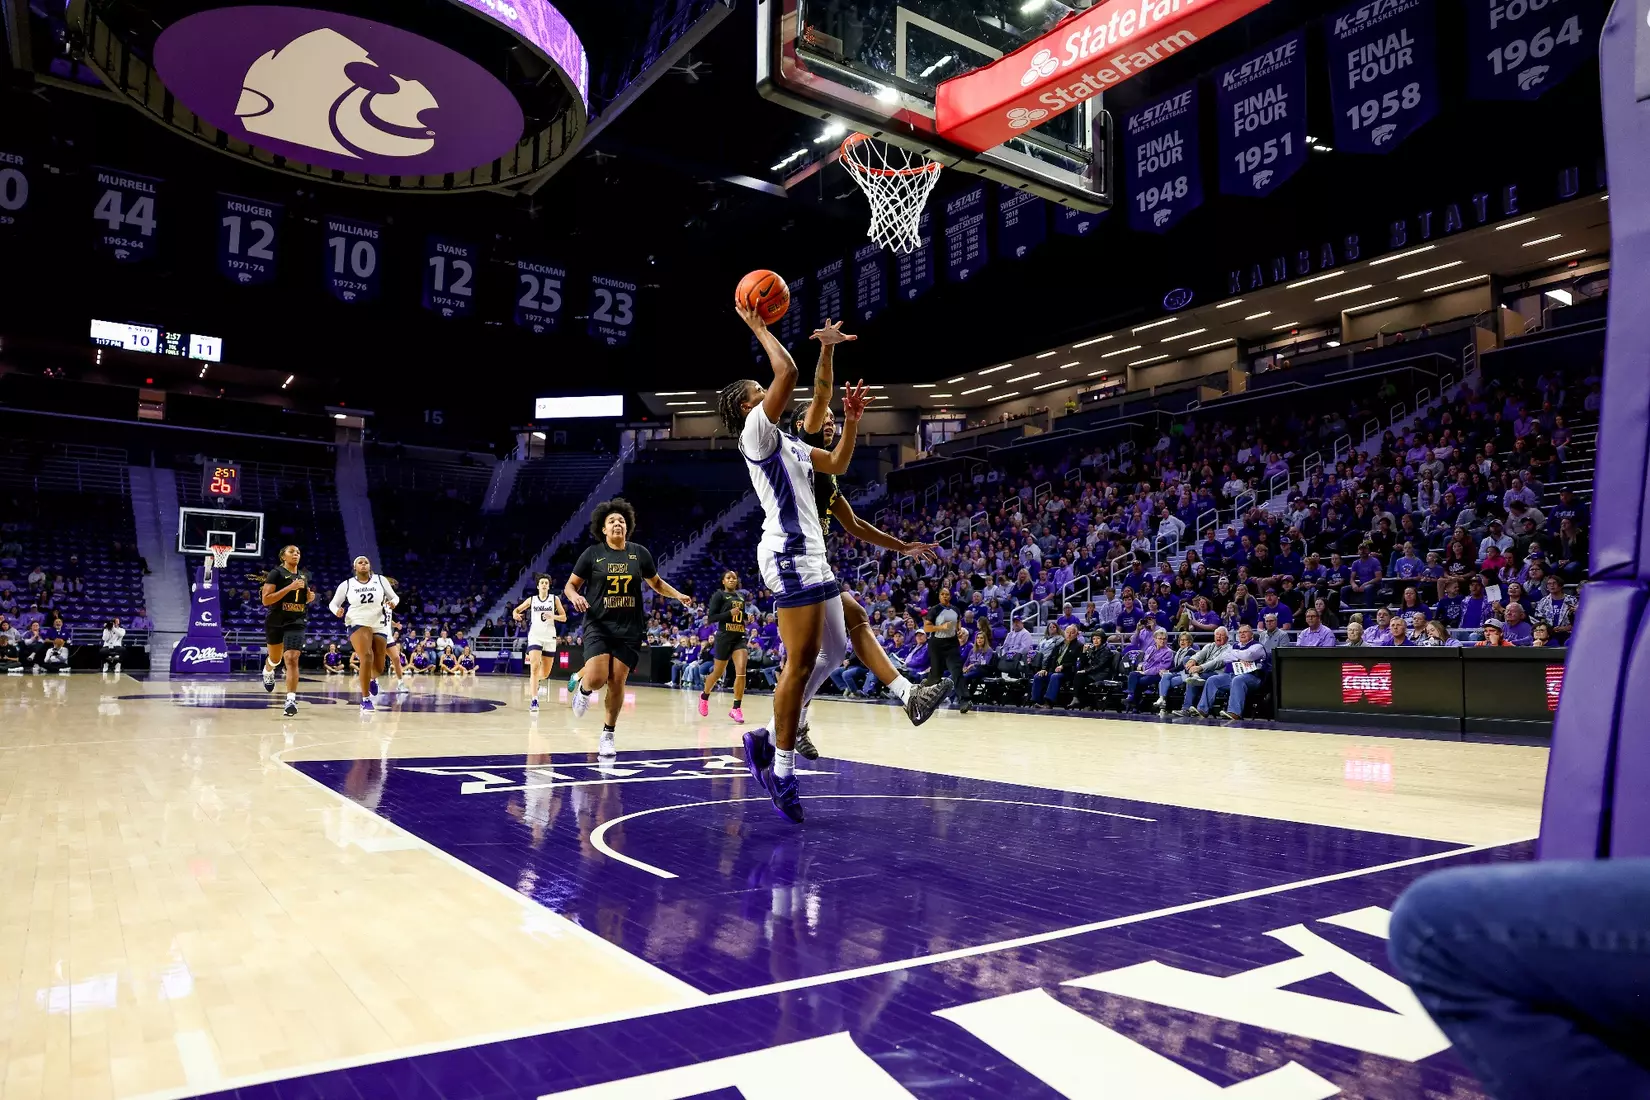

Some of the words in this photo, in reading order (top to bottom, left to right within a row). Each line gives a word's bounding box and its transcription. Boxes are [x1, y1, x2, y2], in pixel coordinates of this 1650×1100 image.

[1347, 27, 1415, 71] FINAL
[1487, 14, 1584, 76] 1964
[1222, 39, 1298, 89] K-STATE
[1348, 47, 1415, 90] FOUR
[1127, 89, 1193, 131] K-STATE
[1233, 83, 1289, 120] FINAL
[1346, 81, 1422, 131] 1958
[1233, 101, 1288, 138] FOUR
[1136, 129, 1184, 162] FINAL
[1234, 131, 1293, 174] 1951
[1137, 146, 1184, 178] FOUR
[97, 173, 157, 194] MURRELL
[1136, 175, 1188, 212] 1948
[227, 201, 273, 218] KRUGER
[947, 188, 983, 213] K-STATE
[1000, 197, 1019, 211] SWEET
[93, 189, 157, 236] 44
[1005, 208, 1019, 220] 2018
[1005, 216, 1019, 227] 2023
[329, 221, 379, 239] WILLIAMS
[945, 222, 962, 236] SWEET
[962, 213, 984, 228] SIXTEEN
[103, 236, 144, 249] 1962-64
[222, 215, 275, 260] 12
[1227, 231, 1361, 294] KANSAS
[1389, 182, 1521, 249] STATE
[328, 236, 377, 278] 10
[436, 243, 468, 257] EVANS
[227, 259, 265, 273] 1971-74
[429, 256, 473, 296] 12
[518, 260, 566, 277] BLACKMAN
[861, 261, 876, 273] NCAA
[333, 279, 367, 291] 1972-76
[518, 274, 562, 312] 25
[592, 275, 637, 291] RICHMOND
[593, 288, 634, 325] 23
[132, 334, 150, 347] 10
[165, 332, 181, 341] 2:57
[197, 344, 212, 356] 11
[423, 409, 444, 425] 15
[214, 467, 235, 478] 2:57
[210, 477, 231, 494] 26
[606, 574, 633, 595] 37
[360, 592, 374, 604] 22
[180, 646, 228, 664] Dillons
[1342, 675, 1392, 691] CENEX
